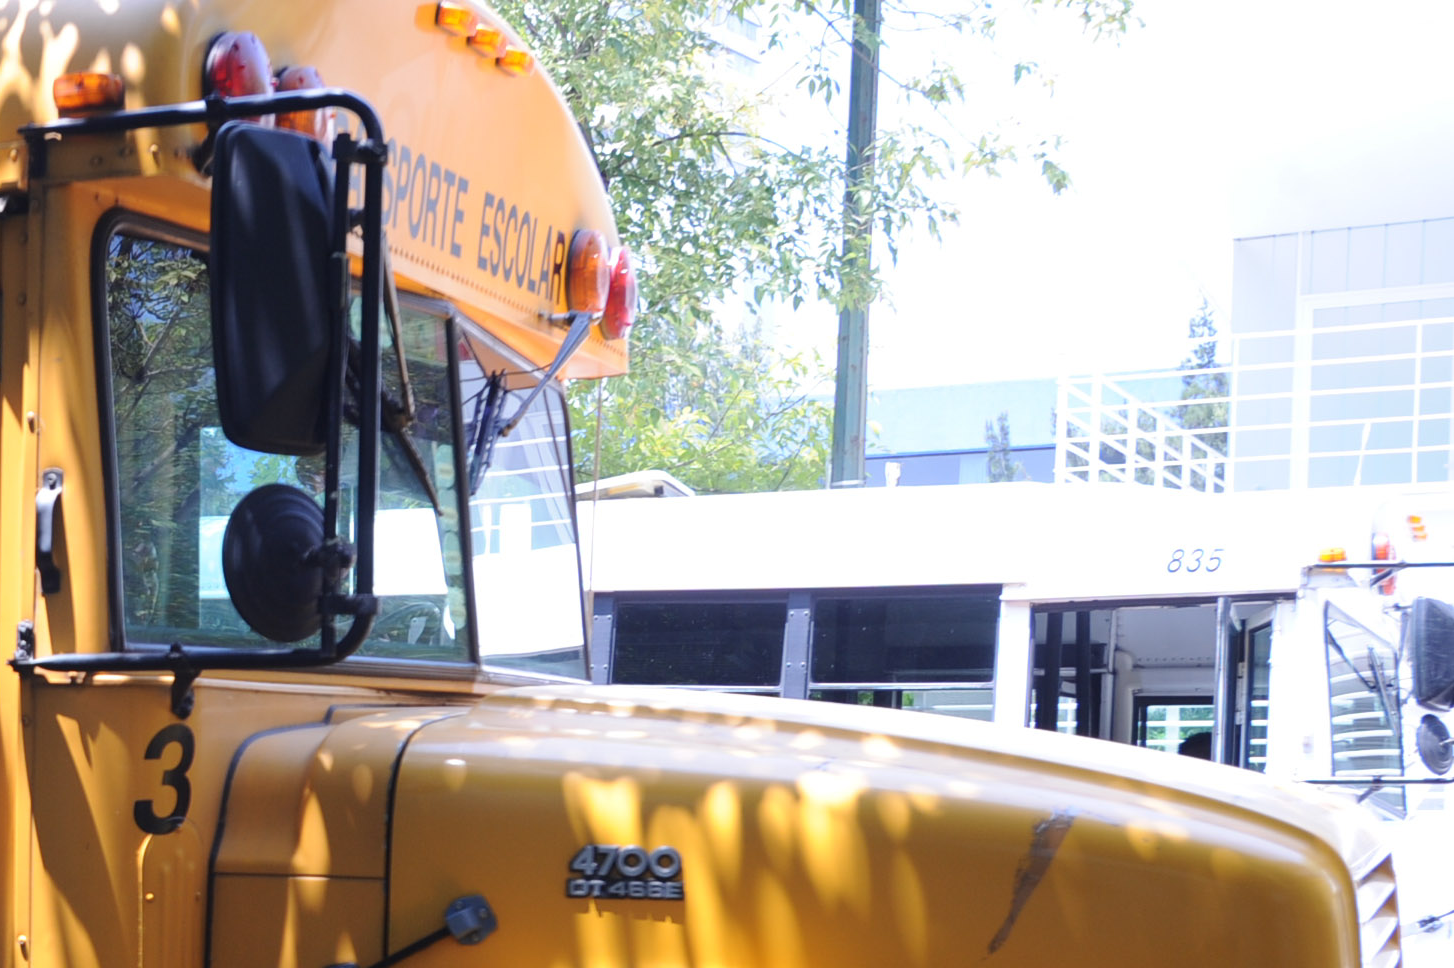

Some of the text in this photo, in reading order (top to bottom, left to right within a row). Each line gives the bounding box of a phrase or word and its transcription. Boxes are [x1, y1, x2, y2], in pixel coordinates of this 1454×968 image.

[477, 191, 566, 305] ESCOLAR
[1166, 548, 1225, 573] 835
[133, 722, 196, 836] 3
[569, 844, 683, 878] 4700
